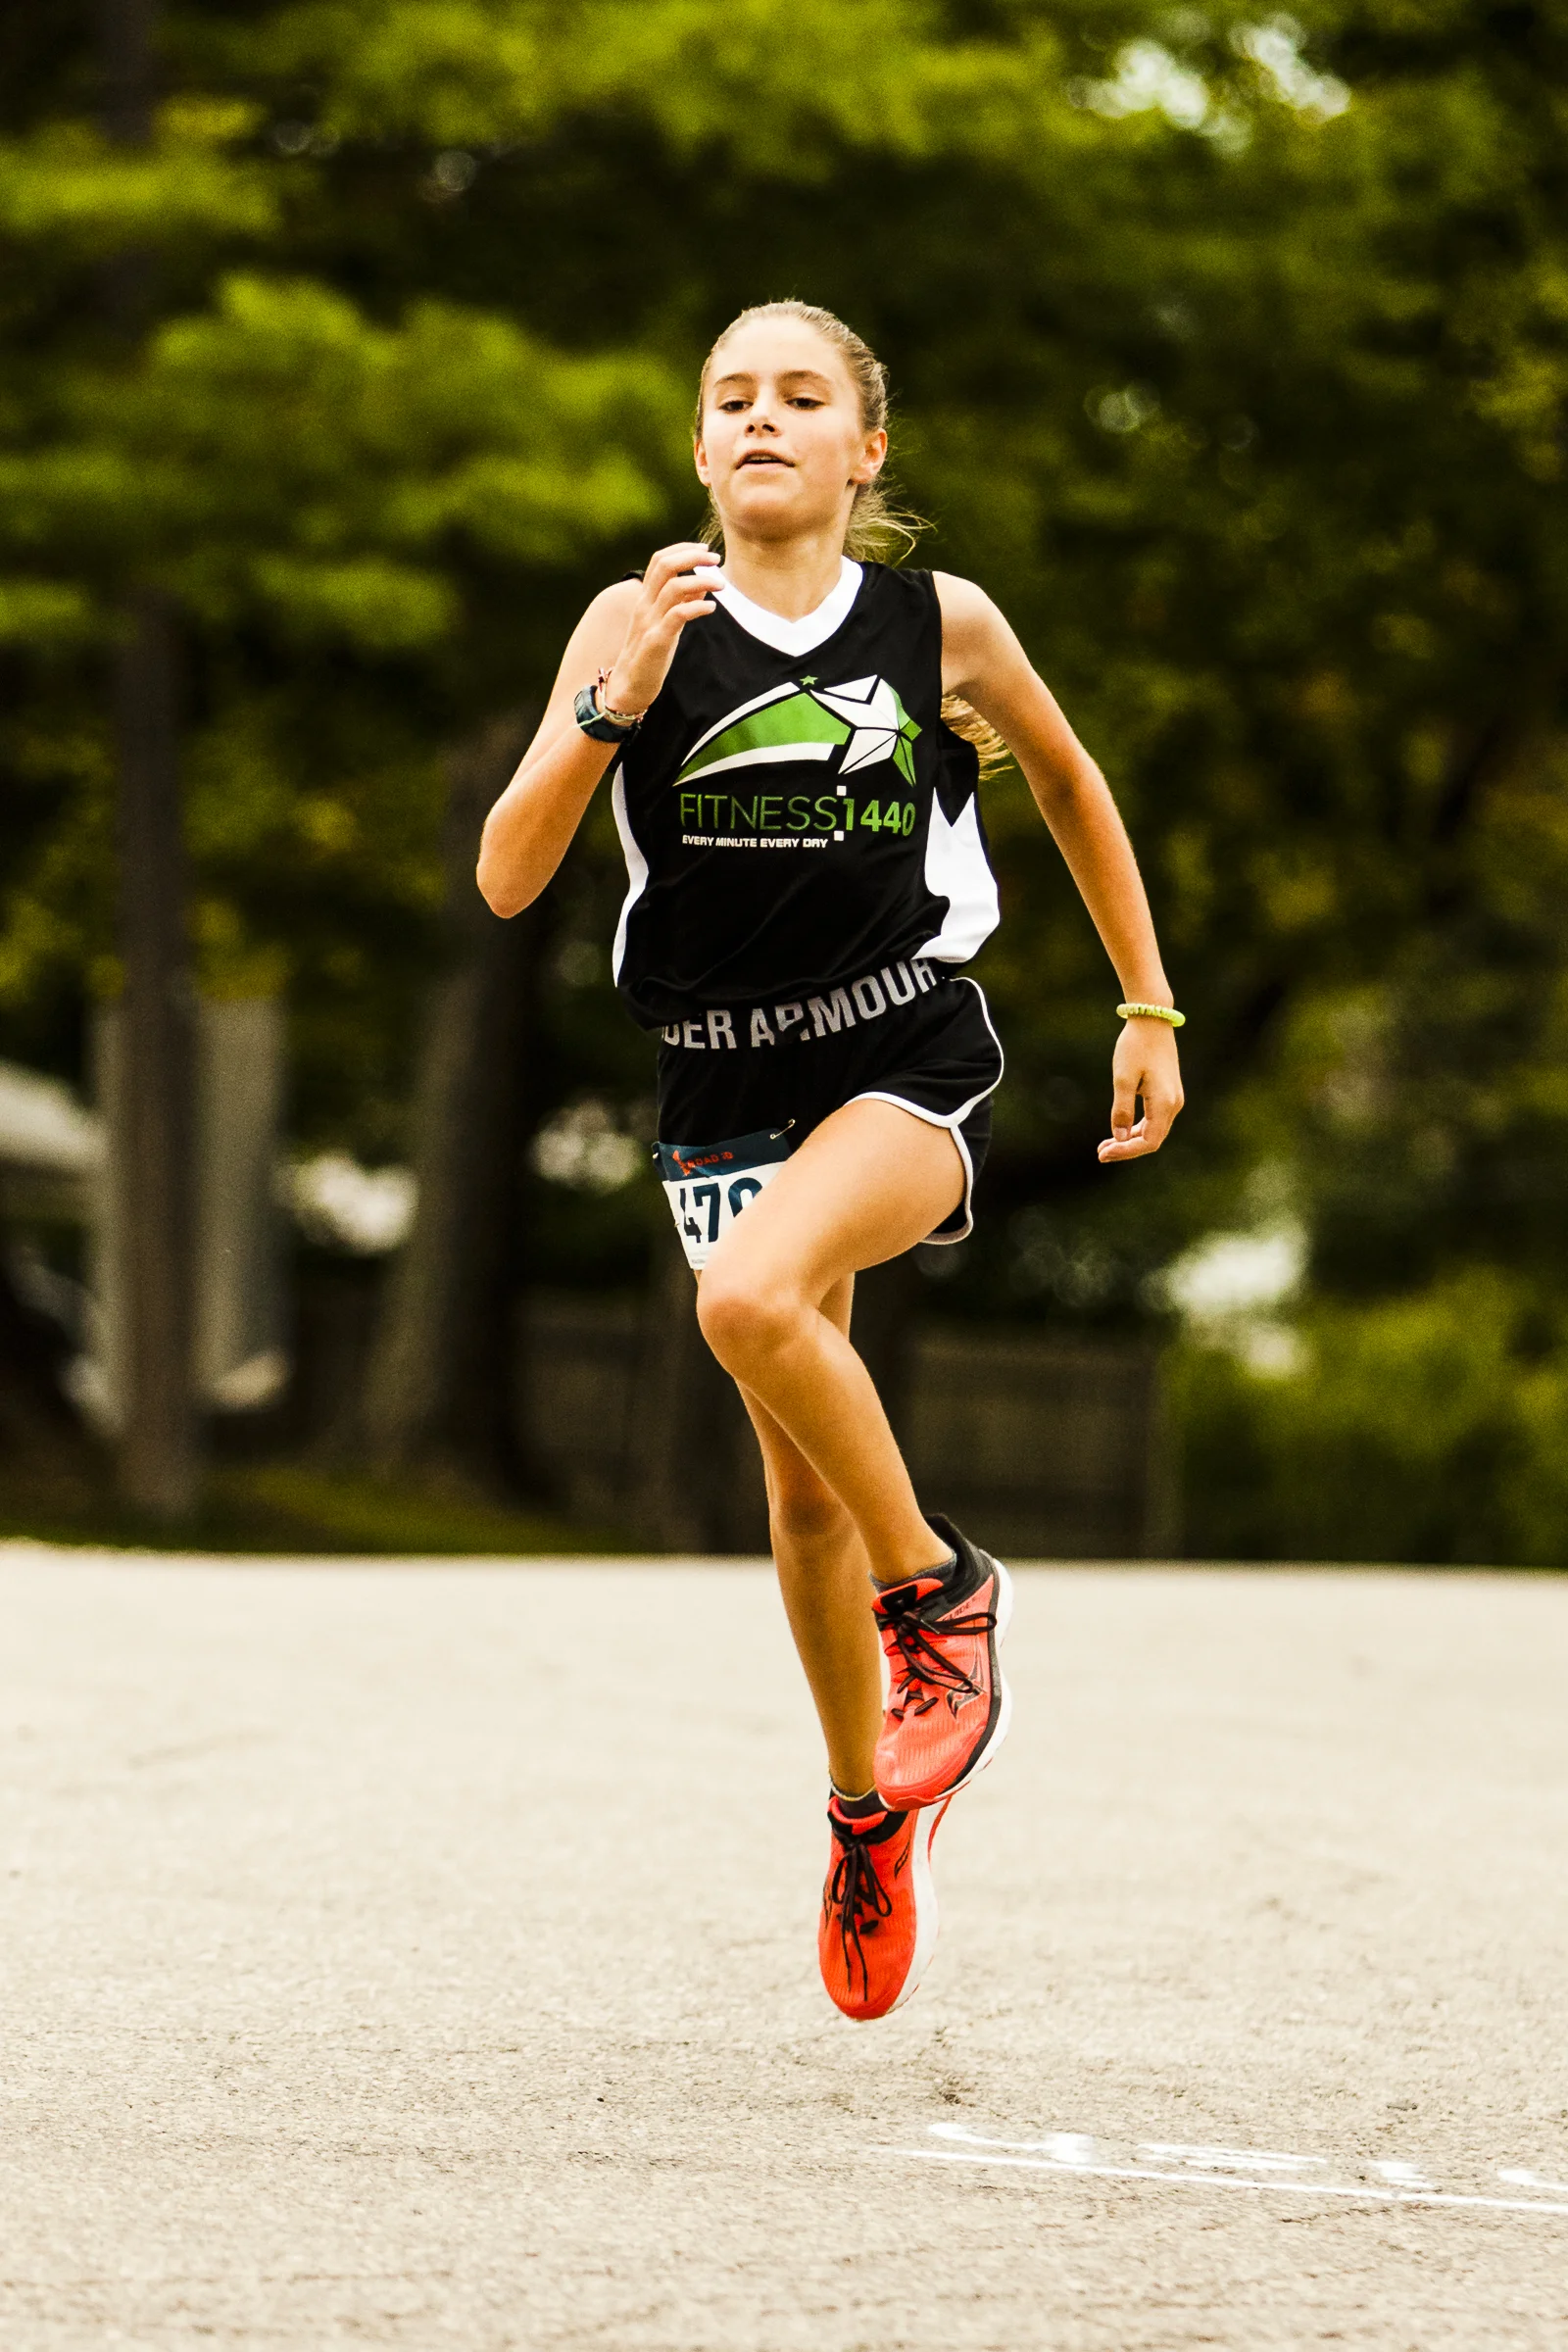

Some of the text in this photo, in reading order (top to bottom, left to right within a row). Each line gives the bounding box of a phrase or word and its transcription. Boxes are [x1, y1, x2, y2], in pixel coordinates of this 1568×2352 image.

[680, 794, 916, 837] FITNESS 1440
[682, 835, 828, 849] EVERY MINUTE EVERY DAY
